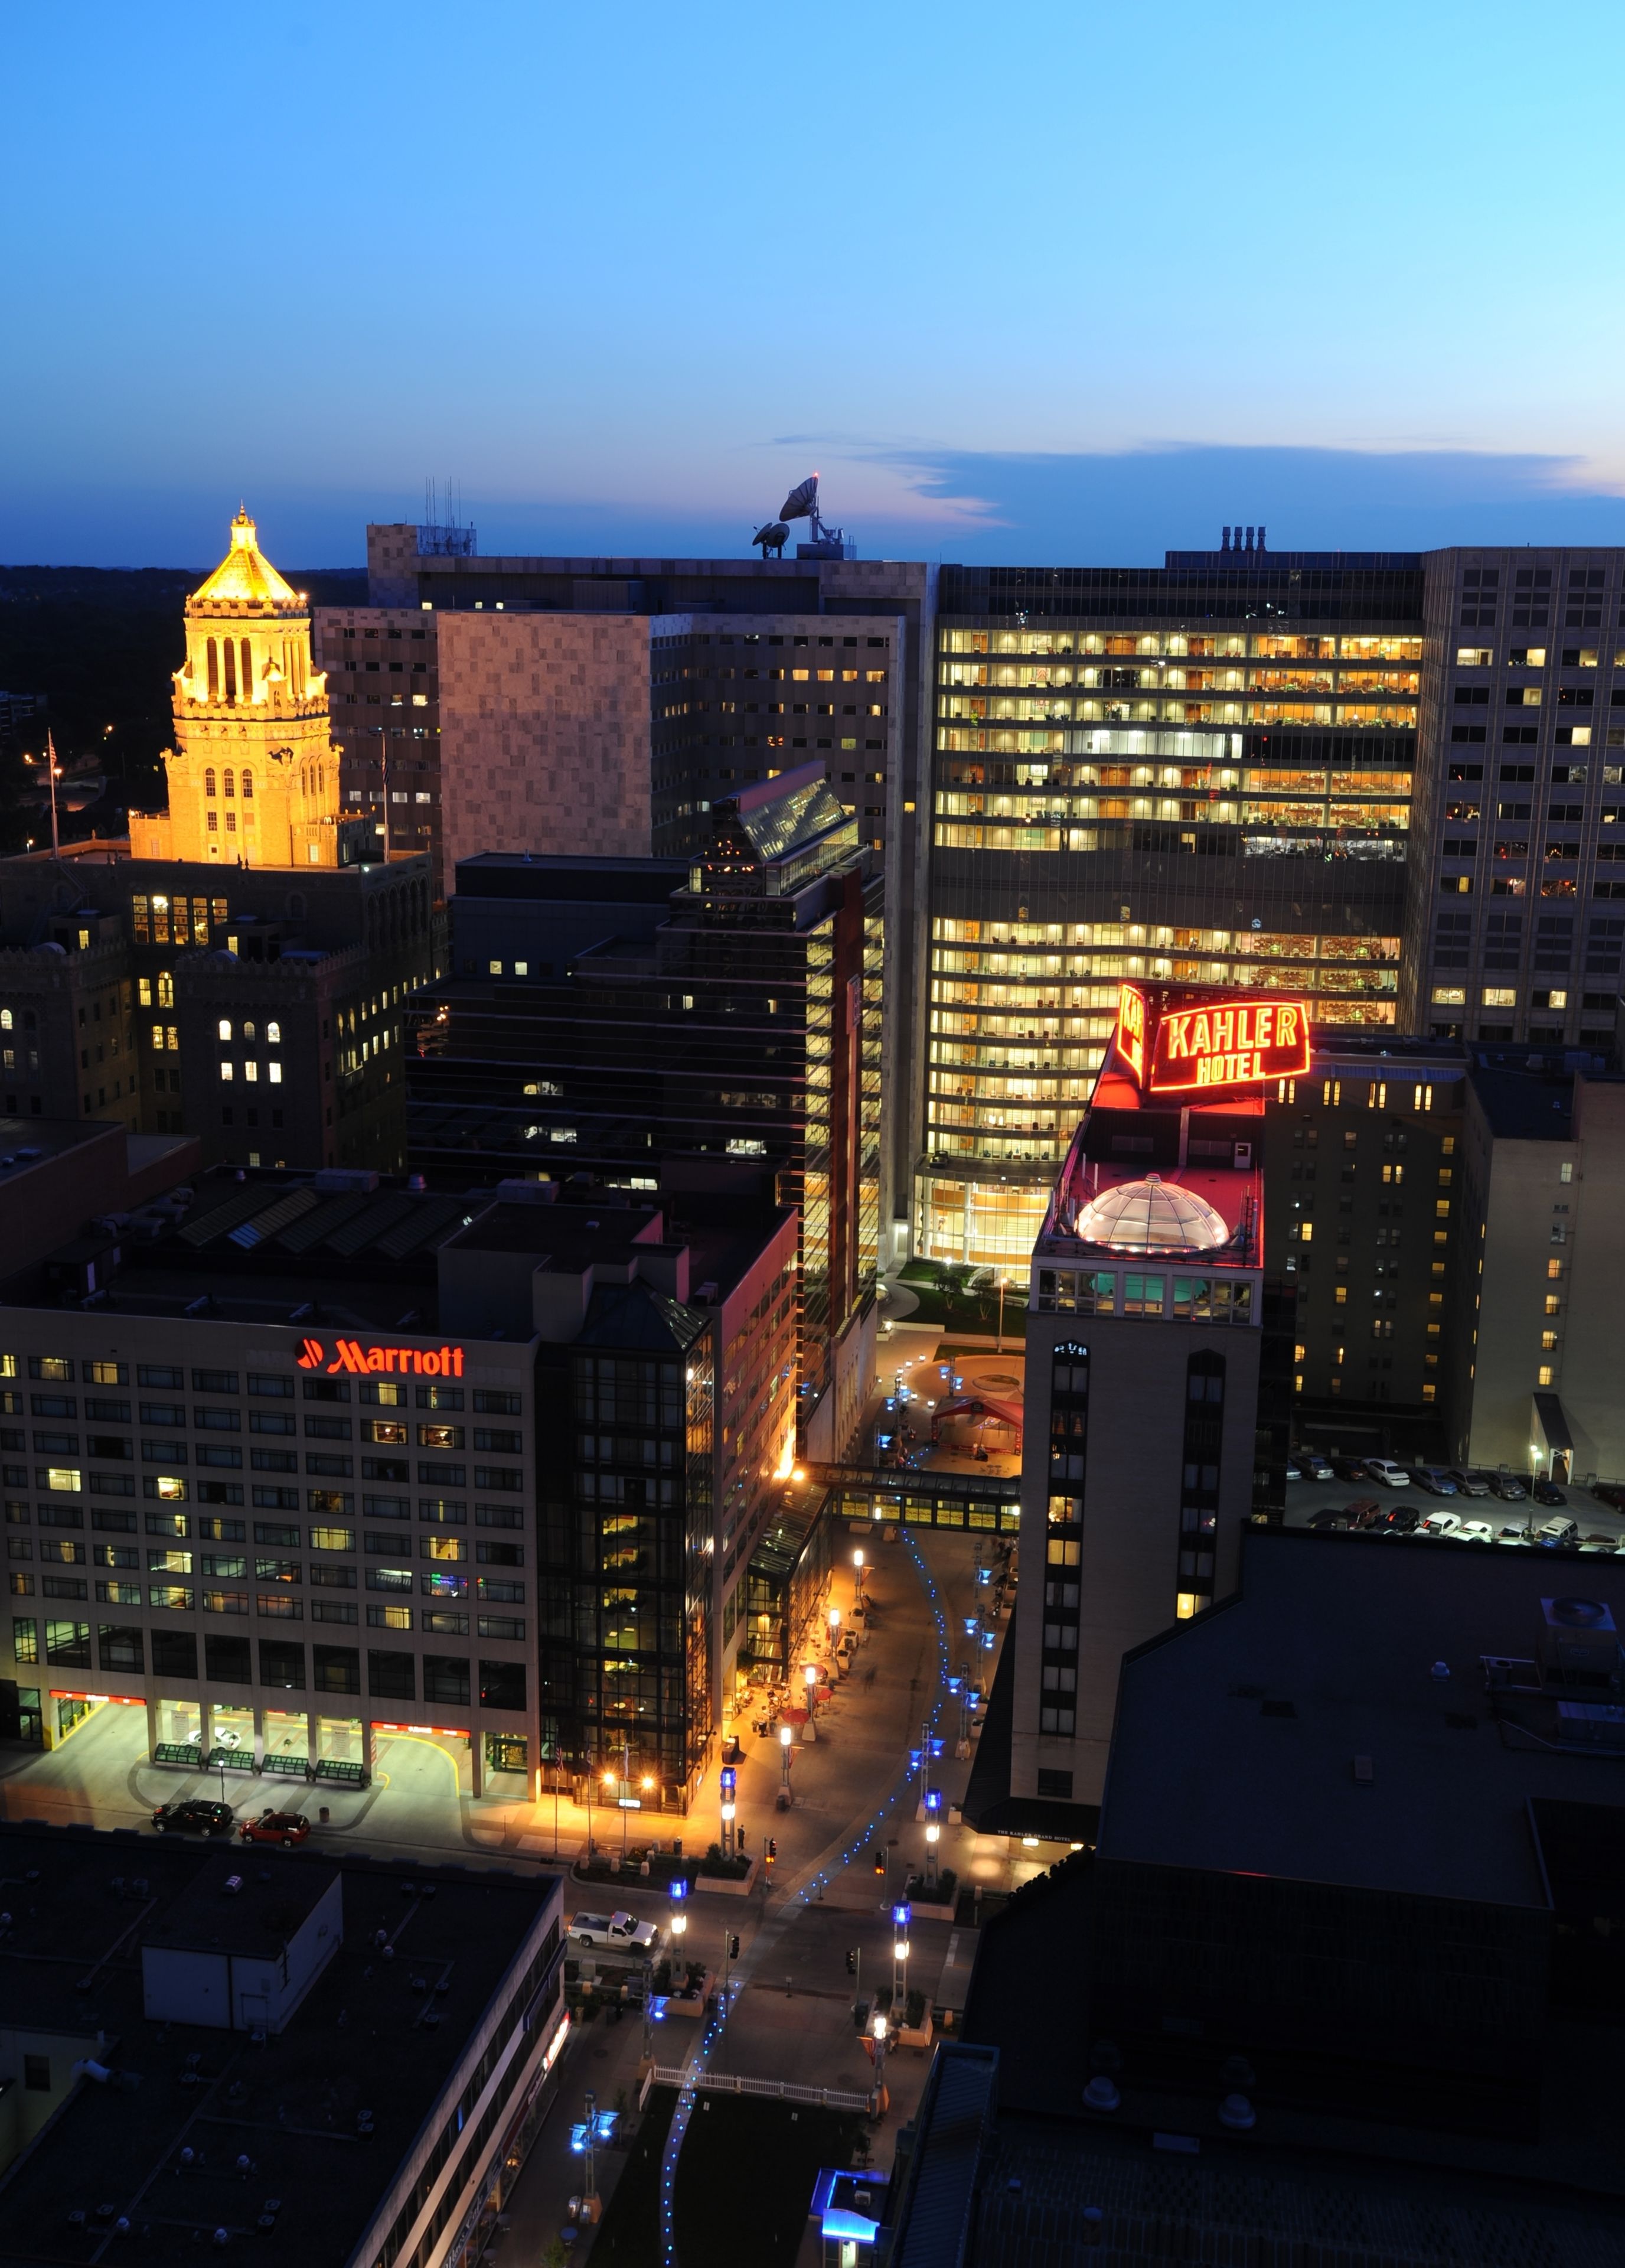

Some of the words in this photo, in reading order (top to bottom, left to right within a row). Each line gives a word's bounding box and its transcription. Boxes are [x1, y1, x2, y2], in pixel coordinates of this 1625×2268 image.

[1169, 1007, 1298, 1059] KAHLER
[1197, 1052, 1266, 1084] HOTEL
[327, 1339, 464, 1377] Marriott
